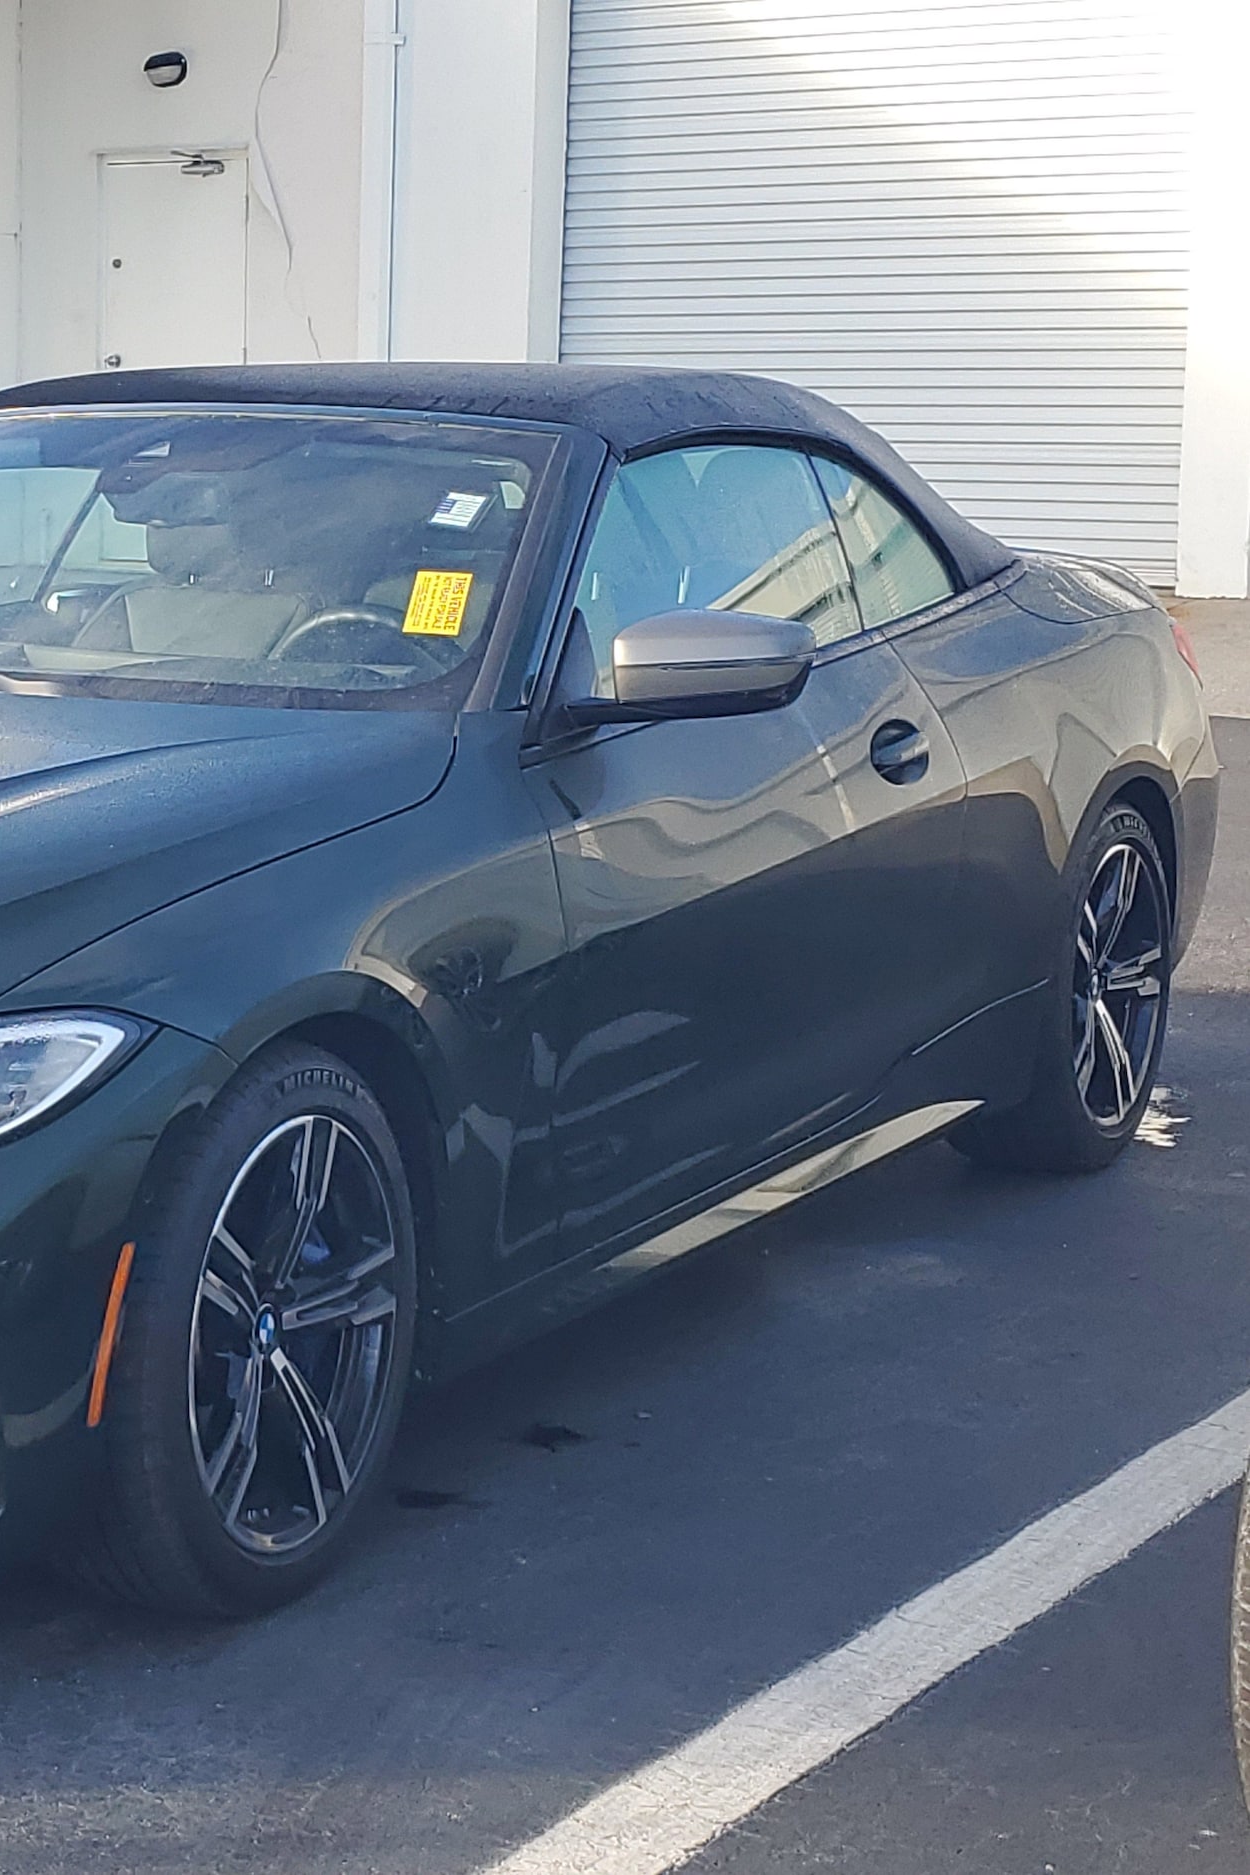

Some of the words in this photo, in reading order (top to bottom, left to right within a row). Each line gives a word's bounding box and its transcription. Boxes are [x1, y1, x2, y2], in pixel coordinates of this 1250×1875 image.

[452, 577, 468, 595] THIS
[443, 596, 463, 631] VEHICLE
[283, 1070, 354, 1094] MICHELIN
